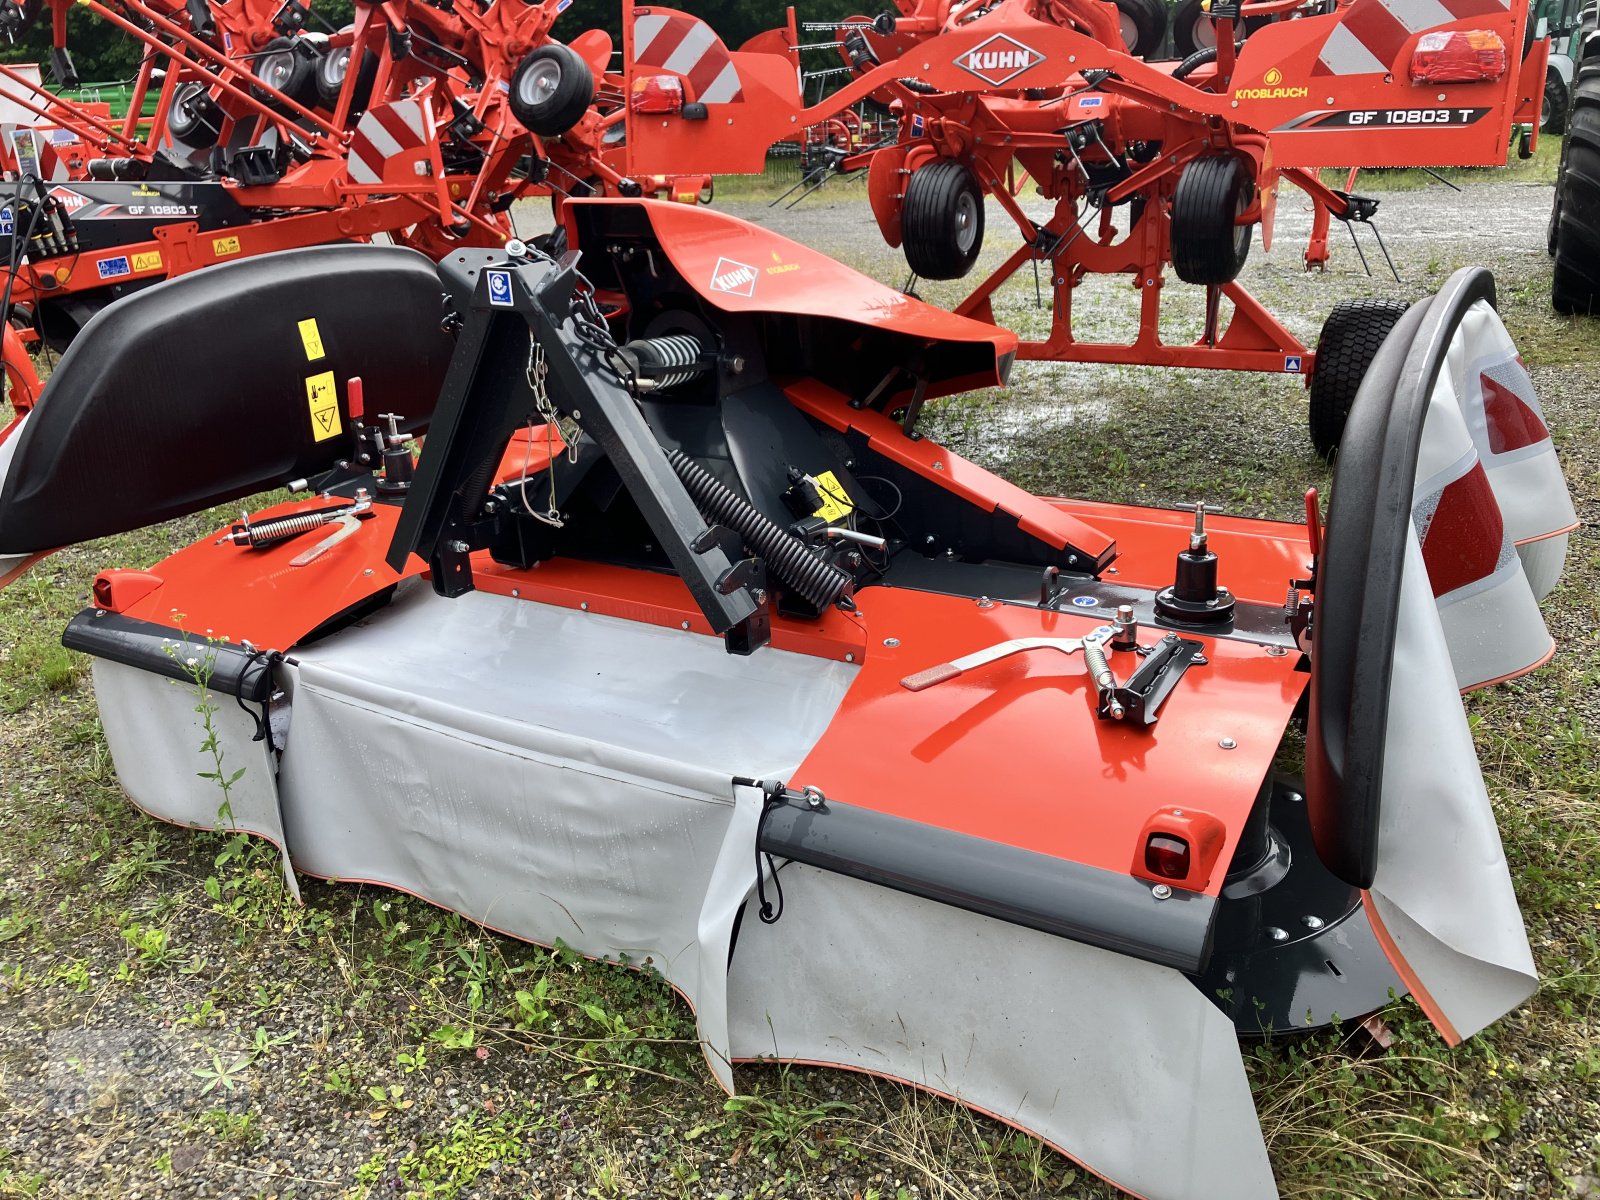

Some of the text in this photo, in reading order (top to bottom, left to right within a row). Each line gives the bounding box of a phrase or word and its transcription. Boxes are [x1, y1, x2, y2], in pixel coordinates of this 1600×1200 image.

[968, 50, 1030, 70] KUHN
[1235, 87, 1309, 100] KNOBLAUCH
[1348, 109, 1474, 125] GF 10803 T
[128, 205, 198, 215] GF 10803 T
[715, 266, 754, 291] KUHN
